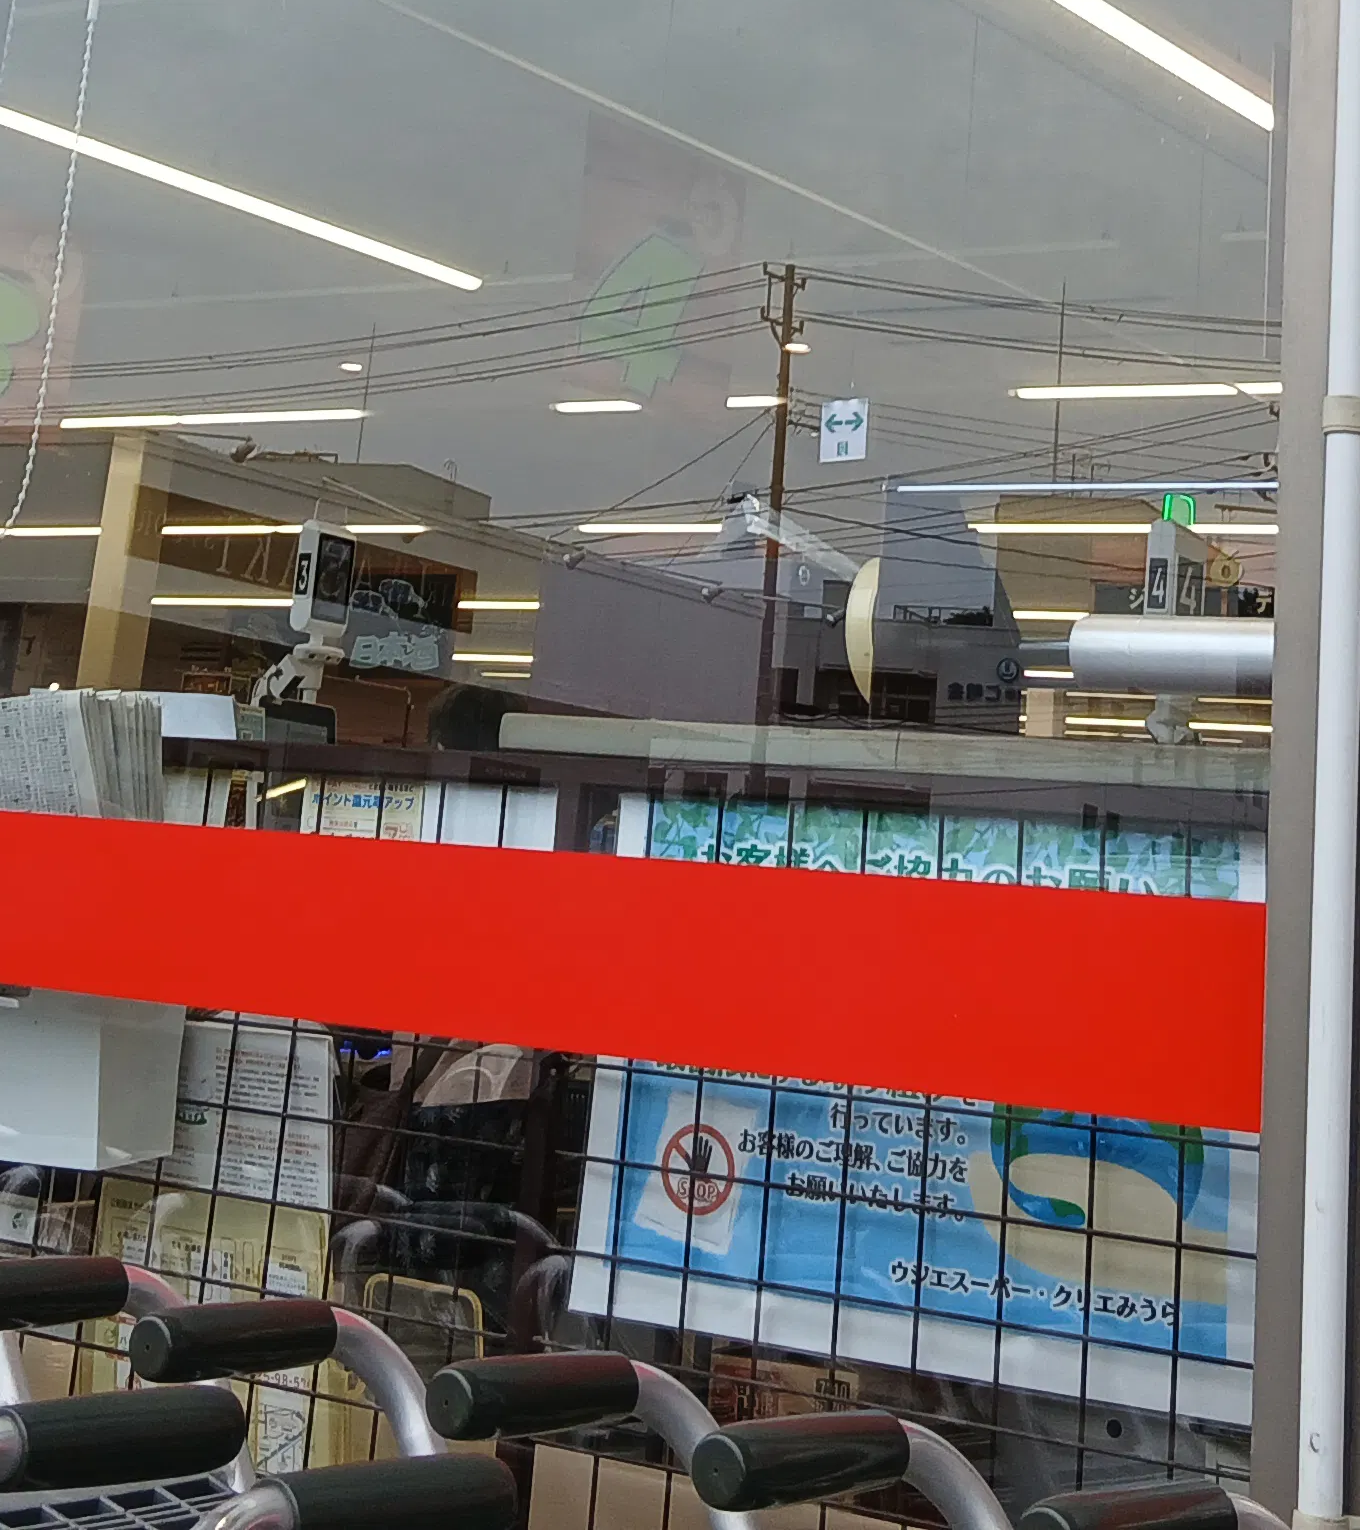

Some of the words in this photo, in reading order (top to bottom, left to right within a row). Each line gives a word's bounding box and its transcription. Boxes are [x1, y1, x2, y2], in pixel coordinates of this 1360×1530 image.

[1151, 567, 1165, 604] 4
[349, 631, 440, 671] 日本酒
[829, 1101, 967, 1146] 行っています。
[737, 1128, 969, 1184] お客様のご理解、ご協力を
[679, 1180, 716, 1199] SOP
[786, 1171, 966, 1223] お願いいたします。
